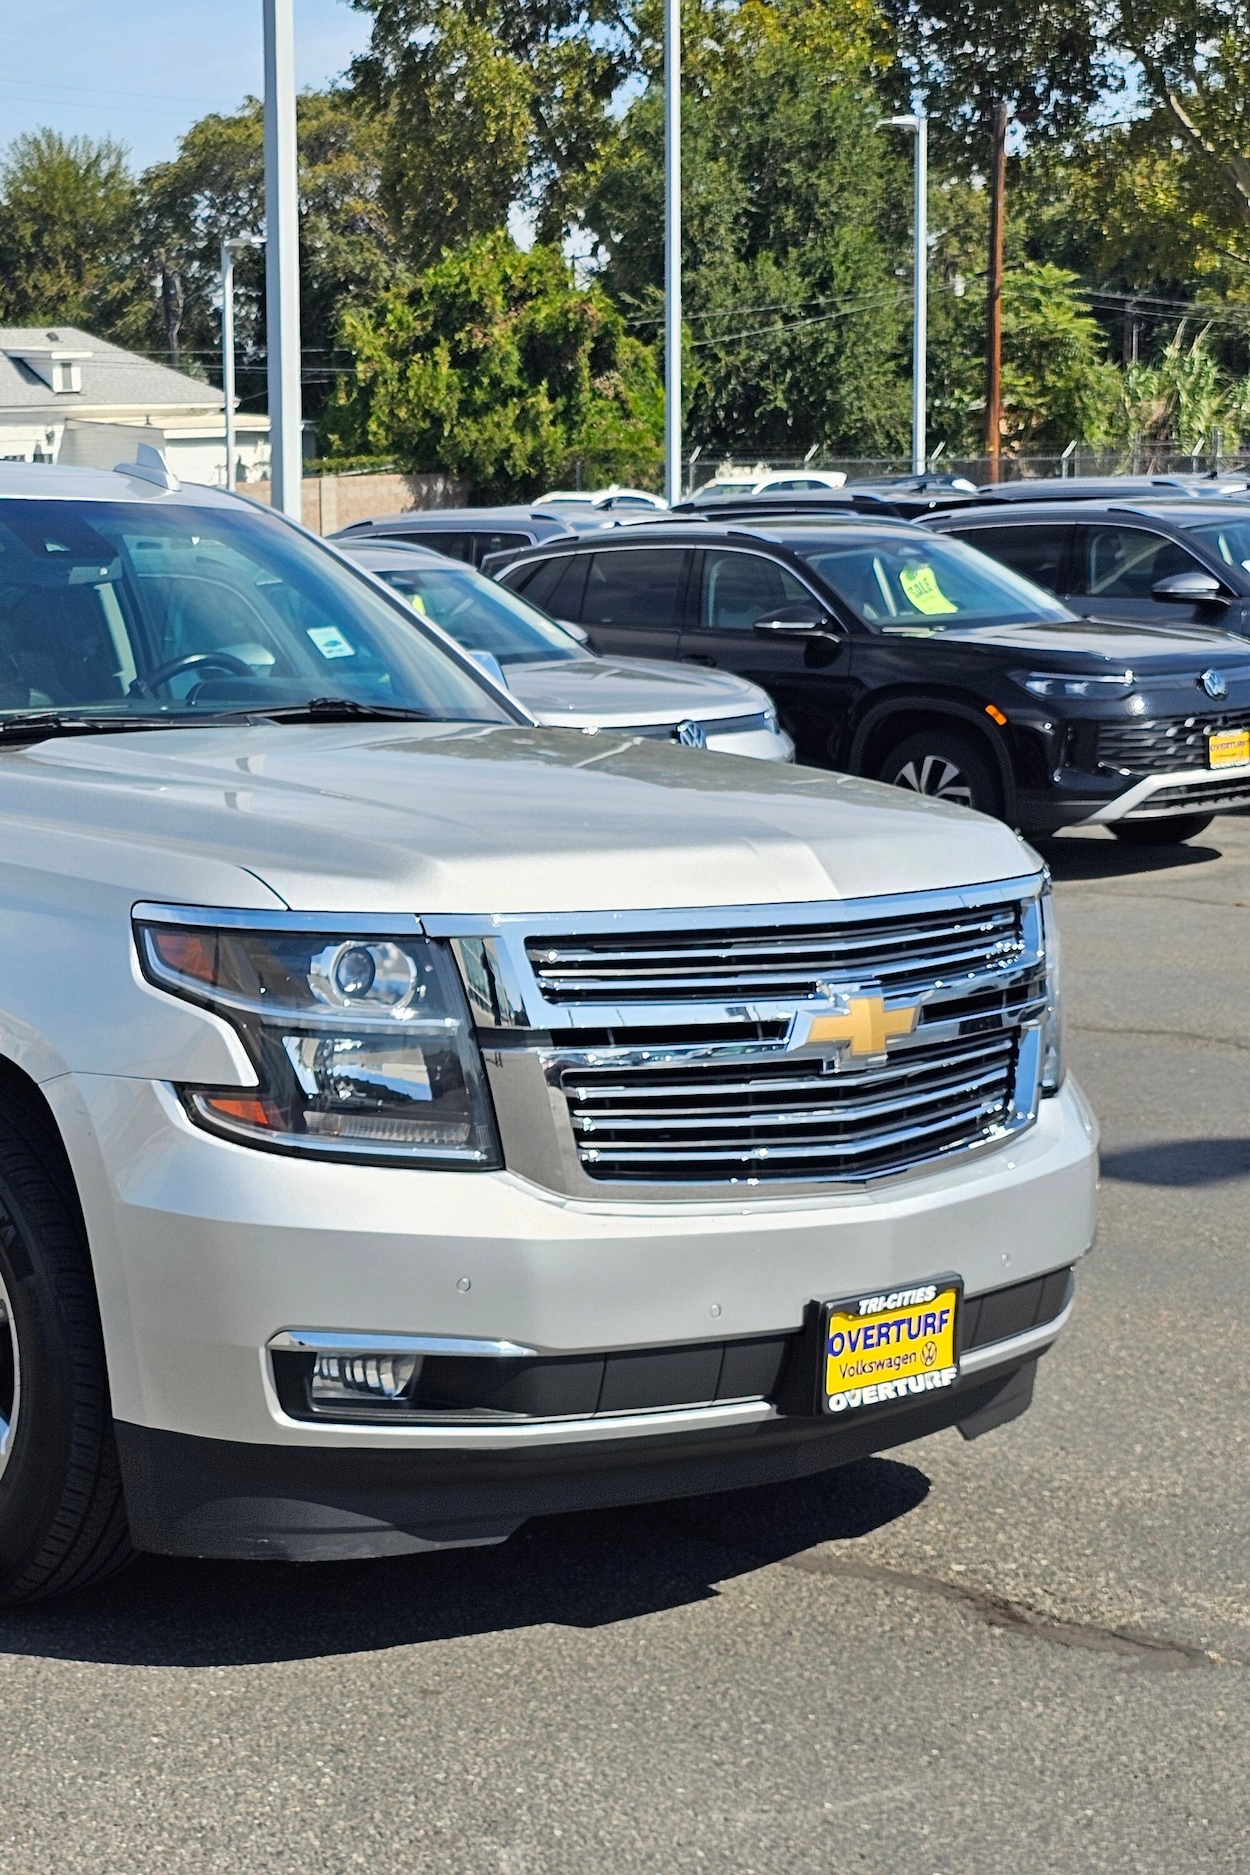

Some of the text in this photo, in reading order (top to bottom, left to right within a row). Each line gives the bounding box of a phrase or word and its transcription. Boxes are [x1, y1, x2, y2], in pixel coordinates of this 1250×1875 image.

[908, 577, 933, 598] SALE
[859, 1285, 937, 1315] TRI-CITIES
[828, 1309, 950, 1357] OVERTURF
[839, 1351, 917, 1379] Volkswagen
[828, 1367, 958, 1412] OVERTURF
